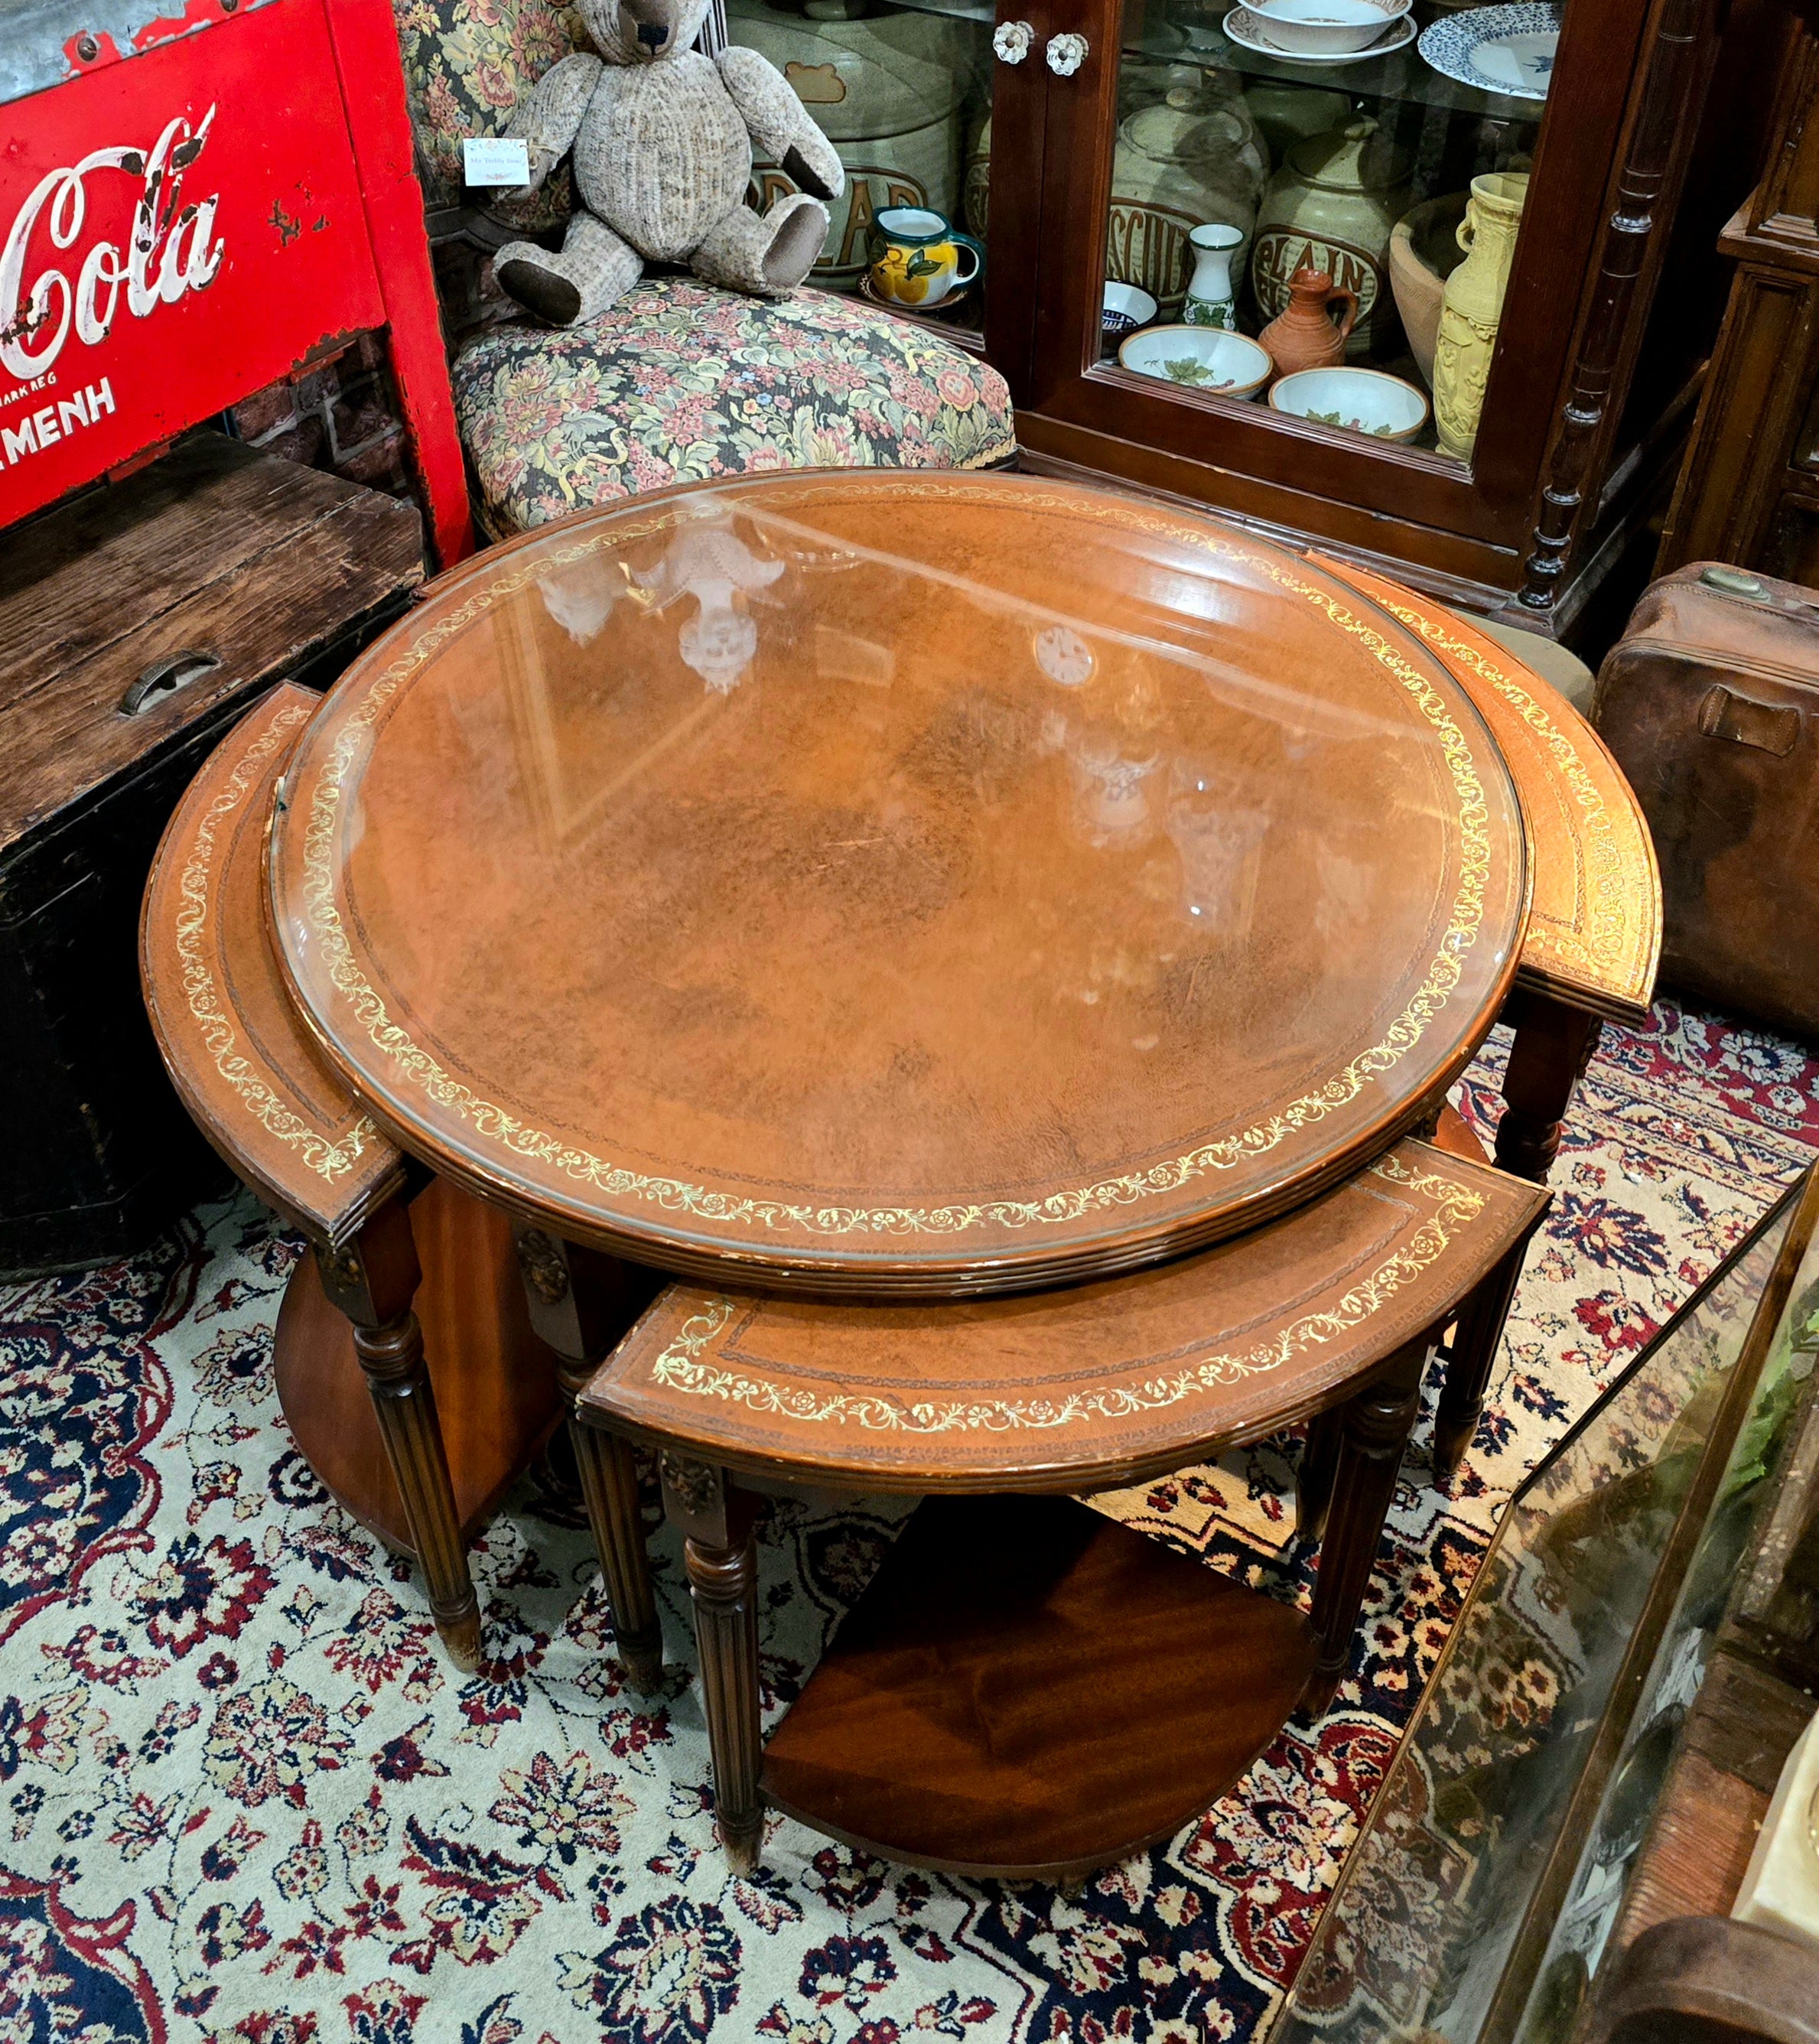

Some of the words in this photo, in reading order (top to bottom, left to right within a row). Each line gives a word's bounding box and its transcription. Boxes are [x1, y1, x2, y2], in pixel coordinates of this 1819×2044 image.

[0, 100, 225, 381] Cola
[1257, 236, 1367, 294] PLAIN
[0, 385, 29, 407] ARK
[0, 376, 116, 471] MENH
